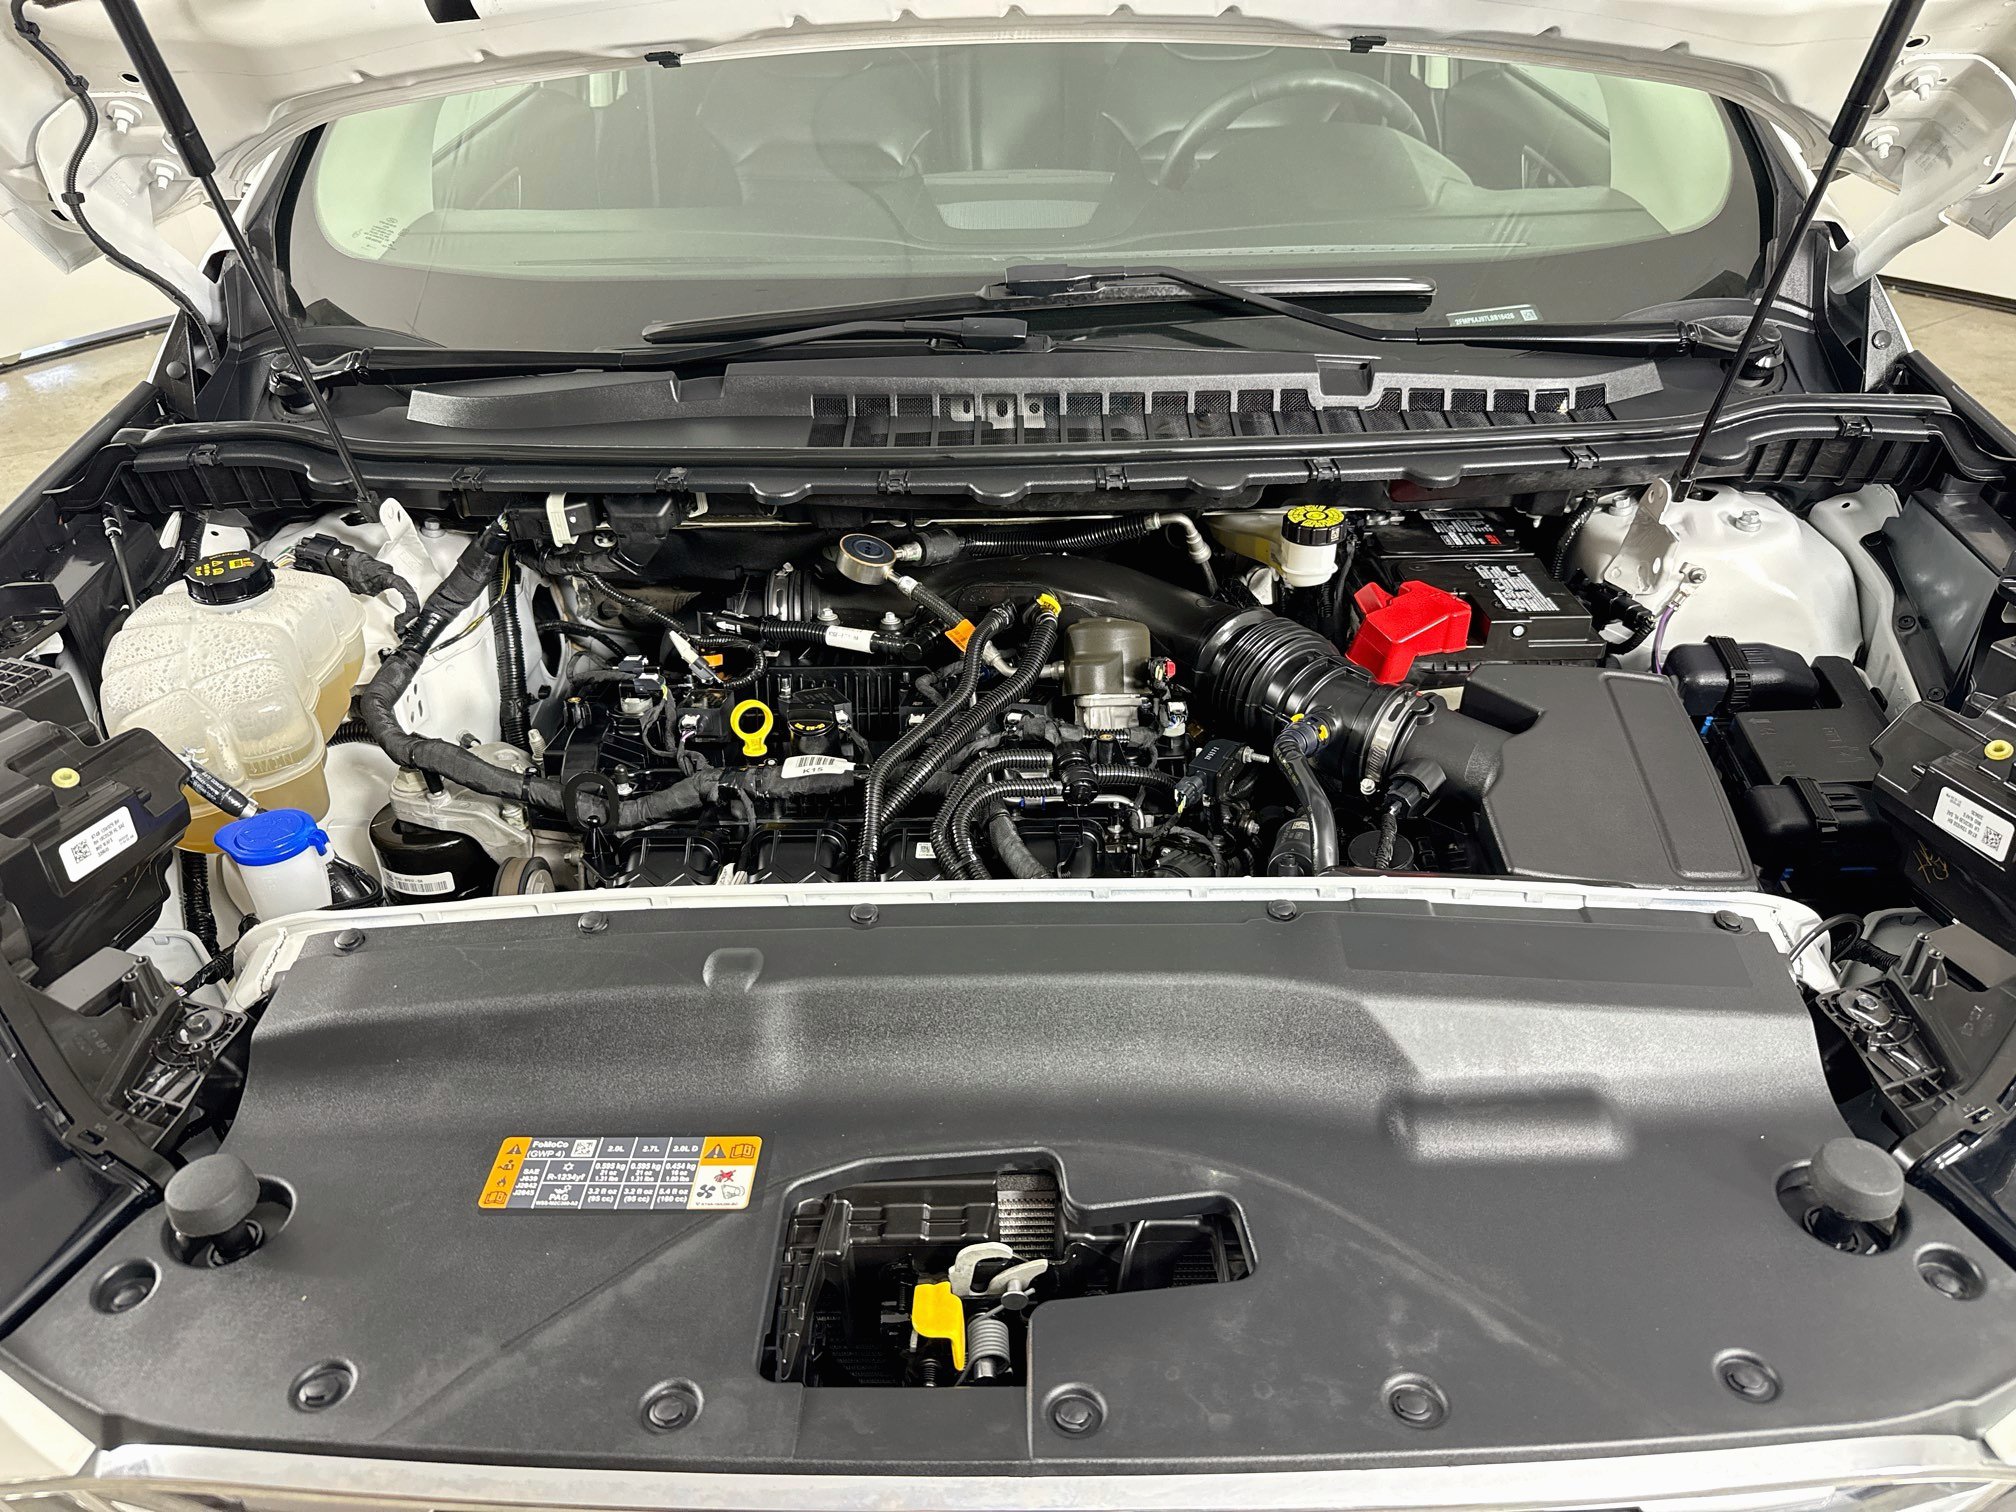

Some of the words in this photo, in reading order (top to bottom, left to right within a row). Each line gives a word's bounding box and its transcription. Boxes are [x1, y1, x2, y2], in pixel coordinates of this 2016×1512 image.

[532, 1140, 569, 1149] FoMoCo
[607, 1145, 625, 1153] 2.0L
[642, 1145, 660, 1153] 2.7L
[672, 1145, 690, 1153] 2.0L
[691, 1145, 699, 1153] D
[526, 1150, 554, 1159] (GWP
[555, 1150, 566, 1159] 4)
[595, 1162, 616, 1170] 0.595
[616, 1162, 627, 1171] kg
[630, 1162, 651, 1170] 0.595
[651, 1162, 662, 1171] kg
[665, 1162, 686, 1170] 0.454
[687, 1162, 697, 1171] kg
[546, 1173, 586, 1182] R-1234yf
[587, 1187, 600, 1195] 3.2
[600, 1187, 606, 1195] fl
[623, 1187, 636, 1195] 3.2
[636, 1187, 643, 1195] fl
[658, 1187, 671, 1195] 5.4
[671, 1187, 678, 1195] fl
[548, 1193, 569, 1201] PAG
[601, 1195, 614, 1203] cc)
[637, 1195, 650, 1203] cc)
[674, 1195, 688, 1203] cc)
